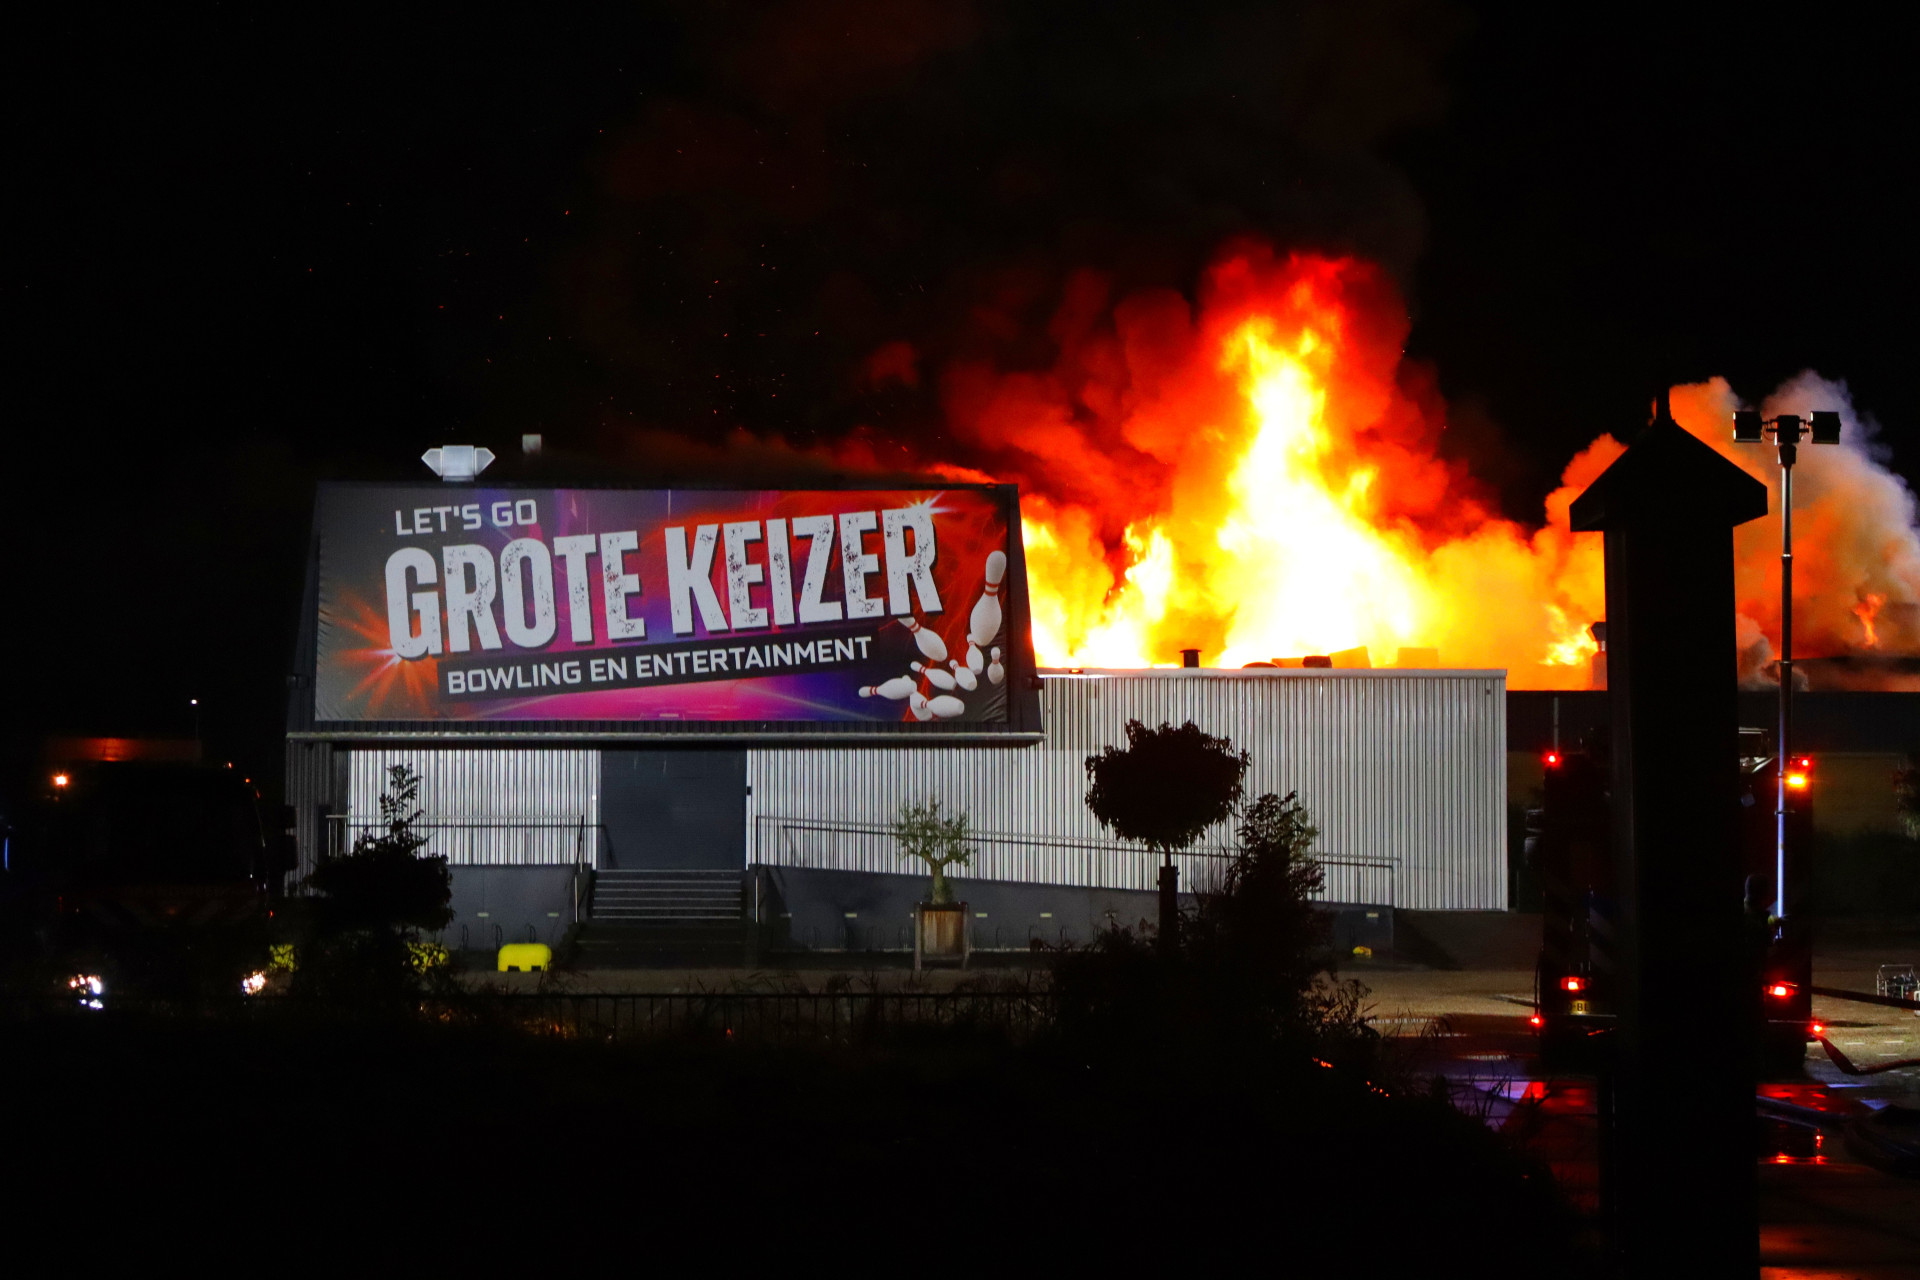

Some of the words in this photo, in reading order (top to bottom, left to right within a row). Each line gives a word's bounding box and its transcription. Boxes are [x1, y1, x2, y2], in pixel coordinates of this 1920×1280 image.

[396, 503, 482, 535] LET'S
[491, 500, 538, 526] GO
[385, 531, 646, 660] GROTE
[664, 506, 943, 635] KEIZER
[448, 660, 582, 694] BOWLING
[591, 658, 629, 682] EN
[636, 636, 872, 678] ENTERTAINMENT
